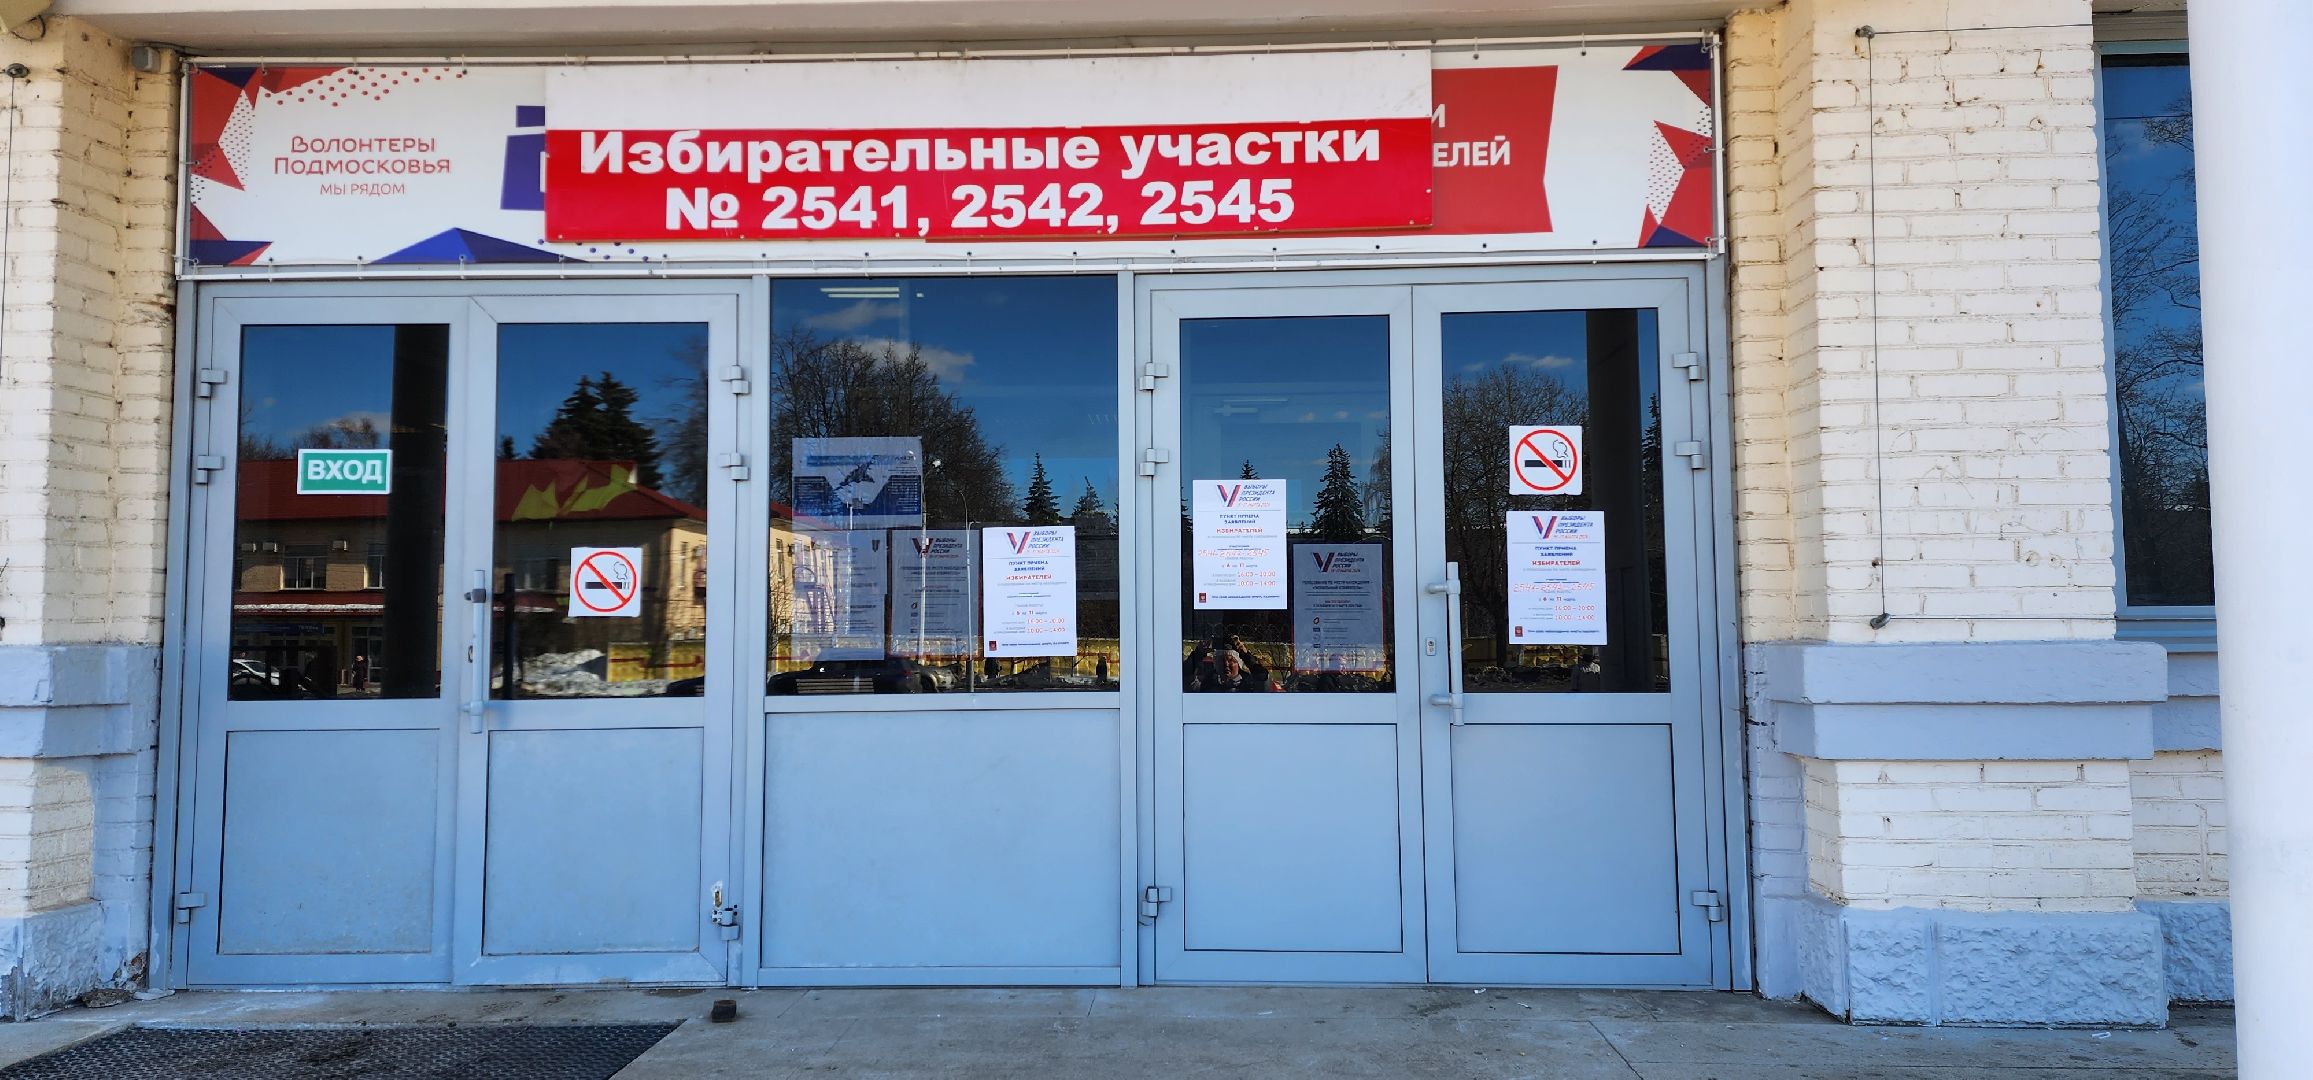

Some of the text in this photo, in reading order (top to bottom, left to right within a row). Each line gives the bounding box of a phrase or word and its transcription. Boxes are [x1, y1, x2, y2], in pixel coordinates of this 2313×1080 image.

[580, 128, 1381, 184] Избирательные участки
[320, 184, 405, 197] МЫ РЯДОМ
[666, 178, 1295, 237] № 2541, 2542, 2545
[307, 459, 383, 484] ВХОД
